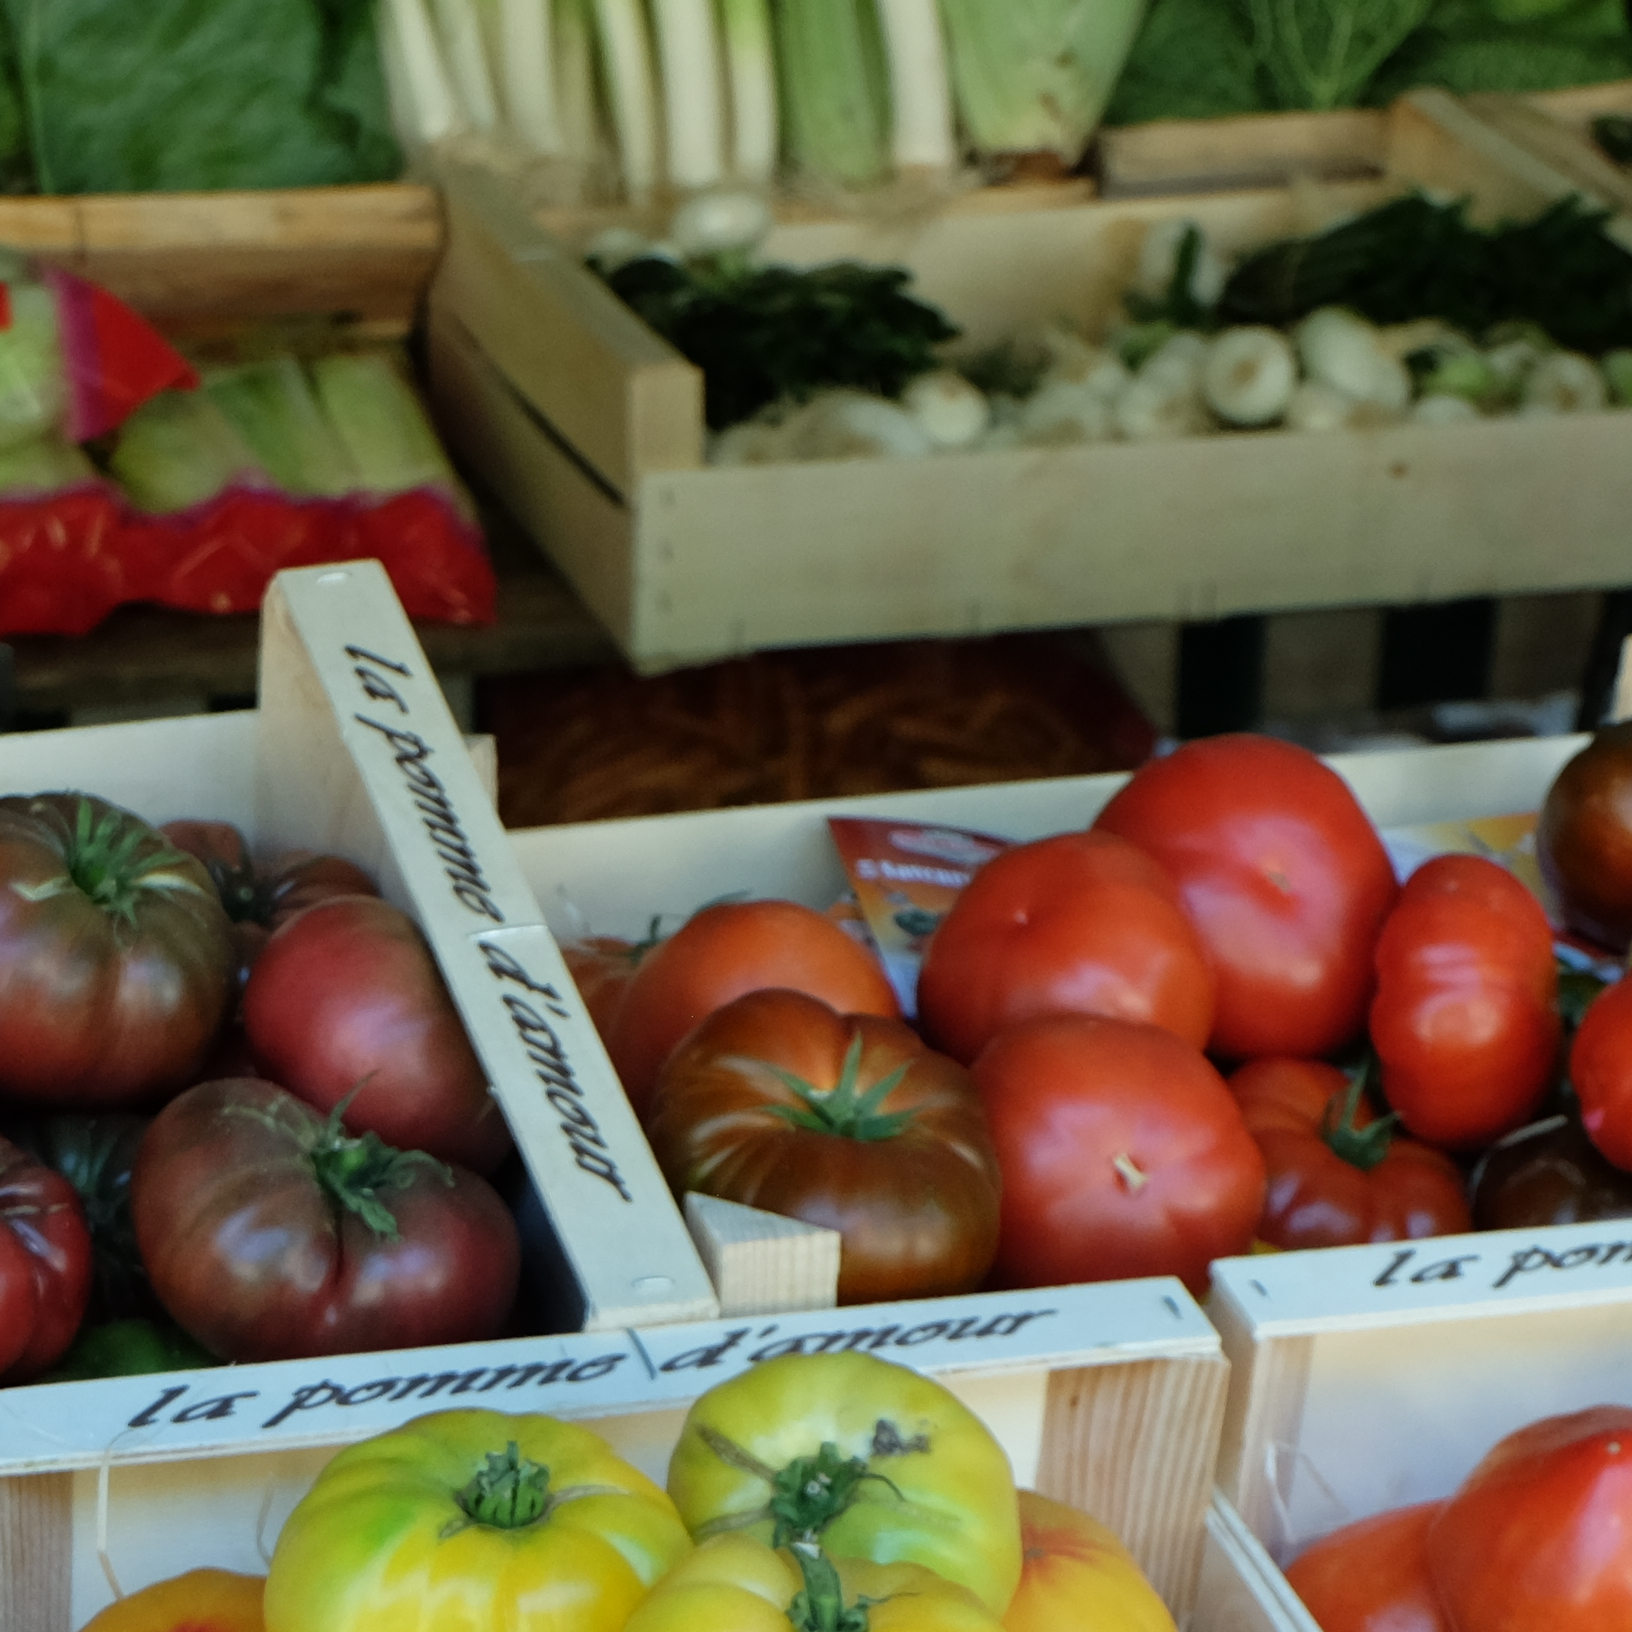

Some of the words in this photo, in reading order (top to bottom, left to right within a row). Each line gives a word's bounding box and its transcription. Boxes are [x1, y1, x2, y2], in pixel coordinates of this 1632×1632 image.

[344, 644, 413, 714] la
[354, 712, 505, 923] pomme
[478, 940, 634, 1203] d'amour
[1373, 1249, 1481, 1288] la
[128, 1385, 259, 1429] la
[261, 1352, 628, 1429] pomme
[659, 1308, 1059, 1373] d'amour
